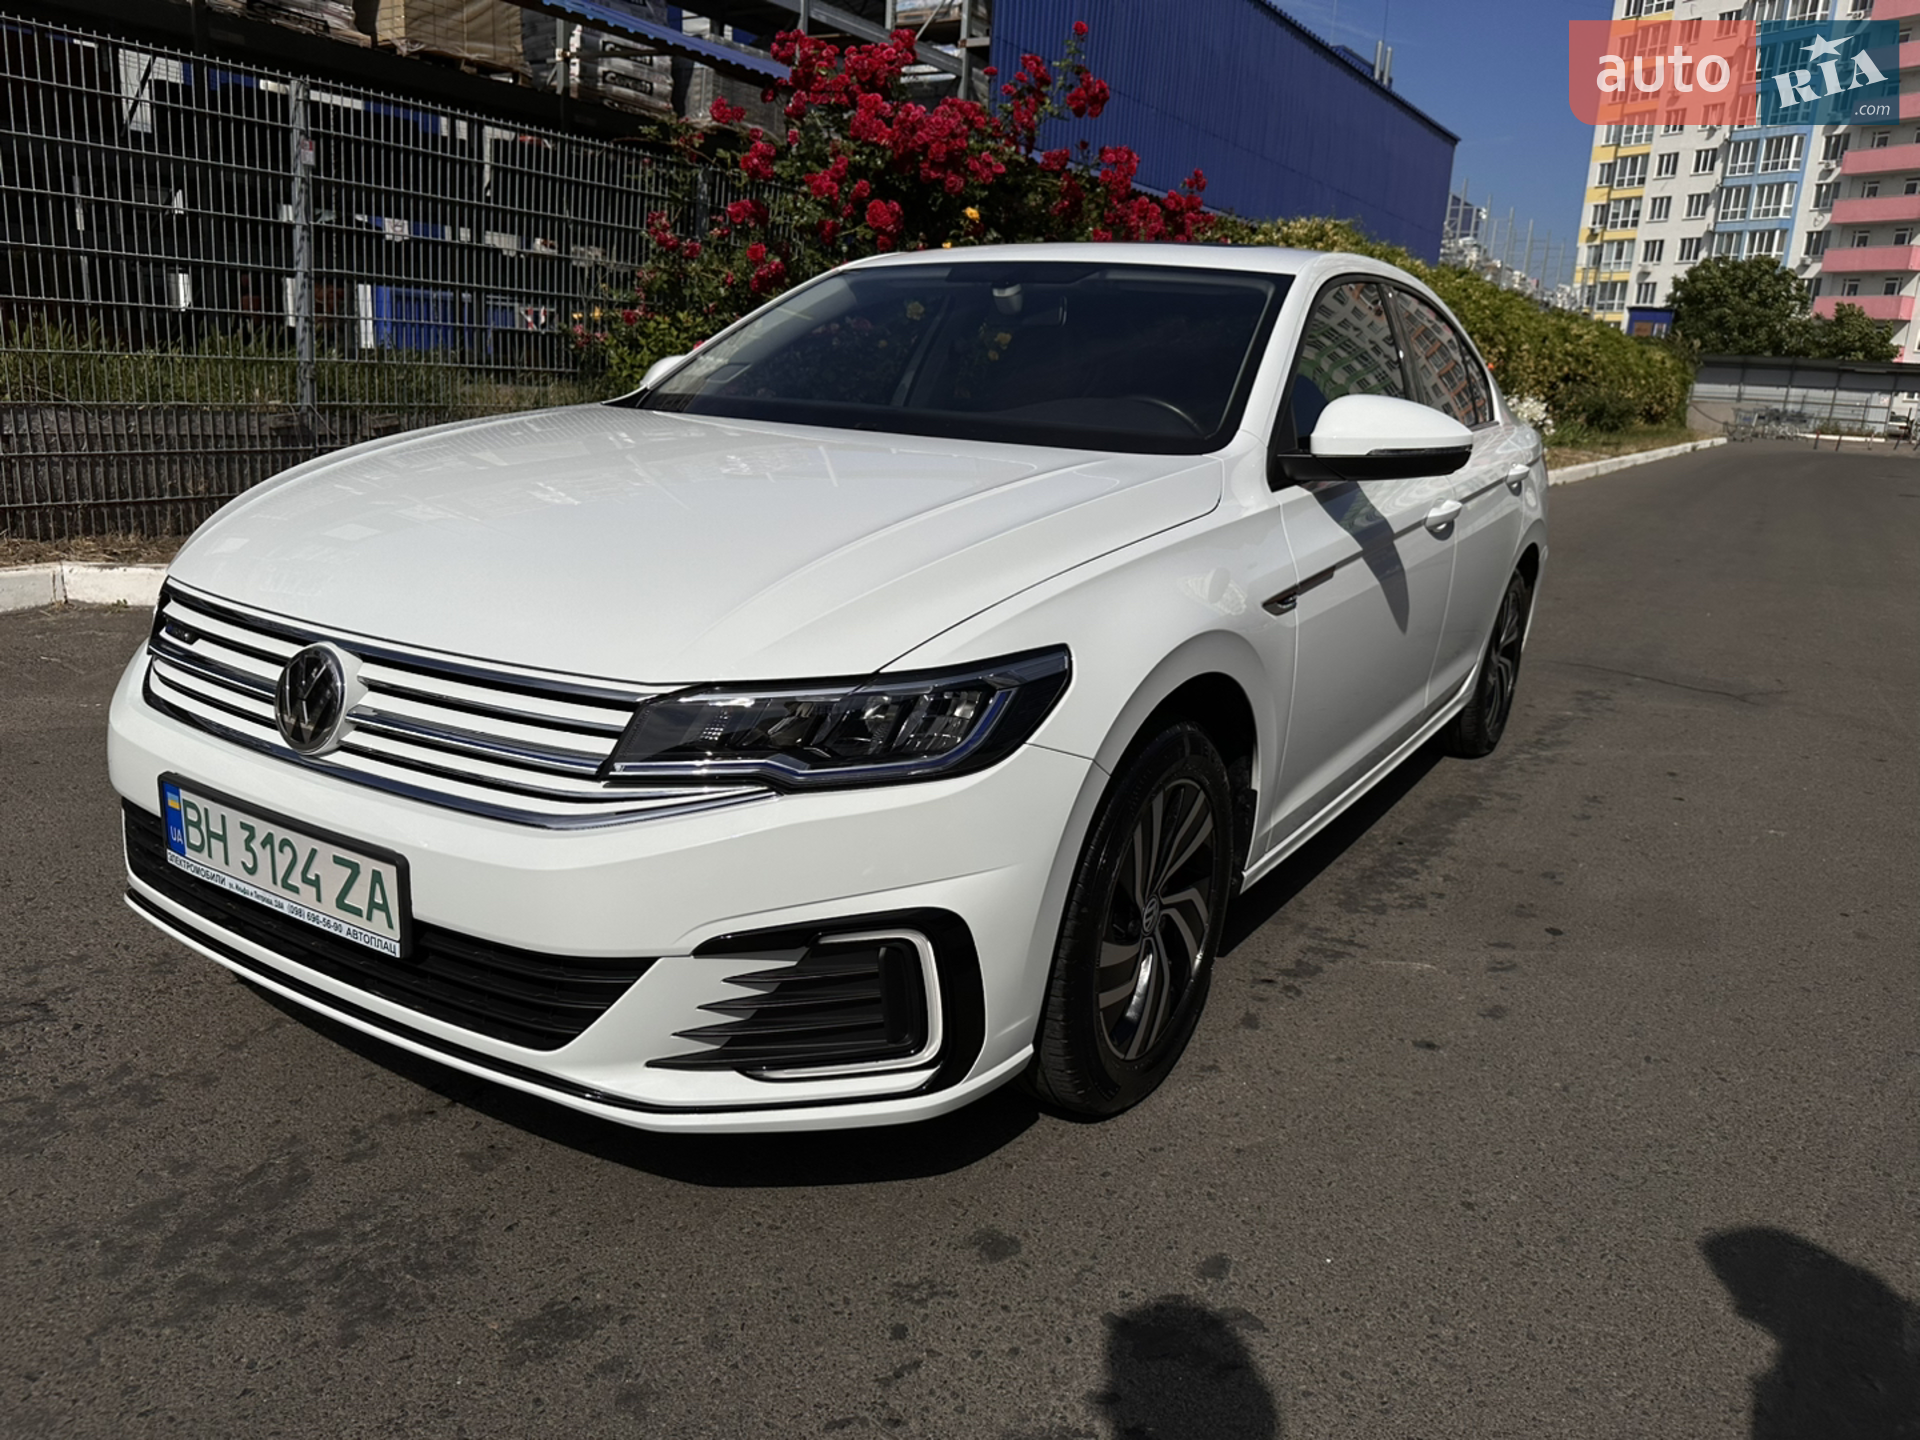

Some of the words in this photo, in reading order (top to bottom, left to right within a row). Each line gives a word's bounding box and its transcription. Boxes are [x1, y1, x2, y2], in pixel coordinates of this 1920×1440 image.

[170, 826, 184, 844] UA
[182, 798, 229, 867] BH
[239, 821, 323, 904] 3124
[332, 854, 395, 930] ZA
[167, 851, 226, 887] ЭЛЕКТРОМОБИЛИ
[346, 927, 397, 956] АВТОПЛАЦ
